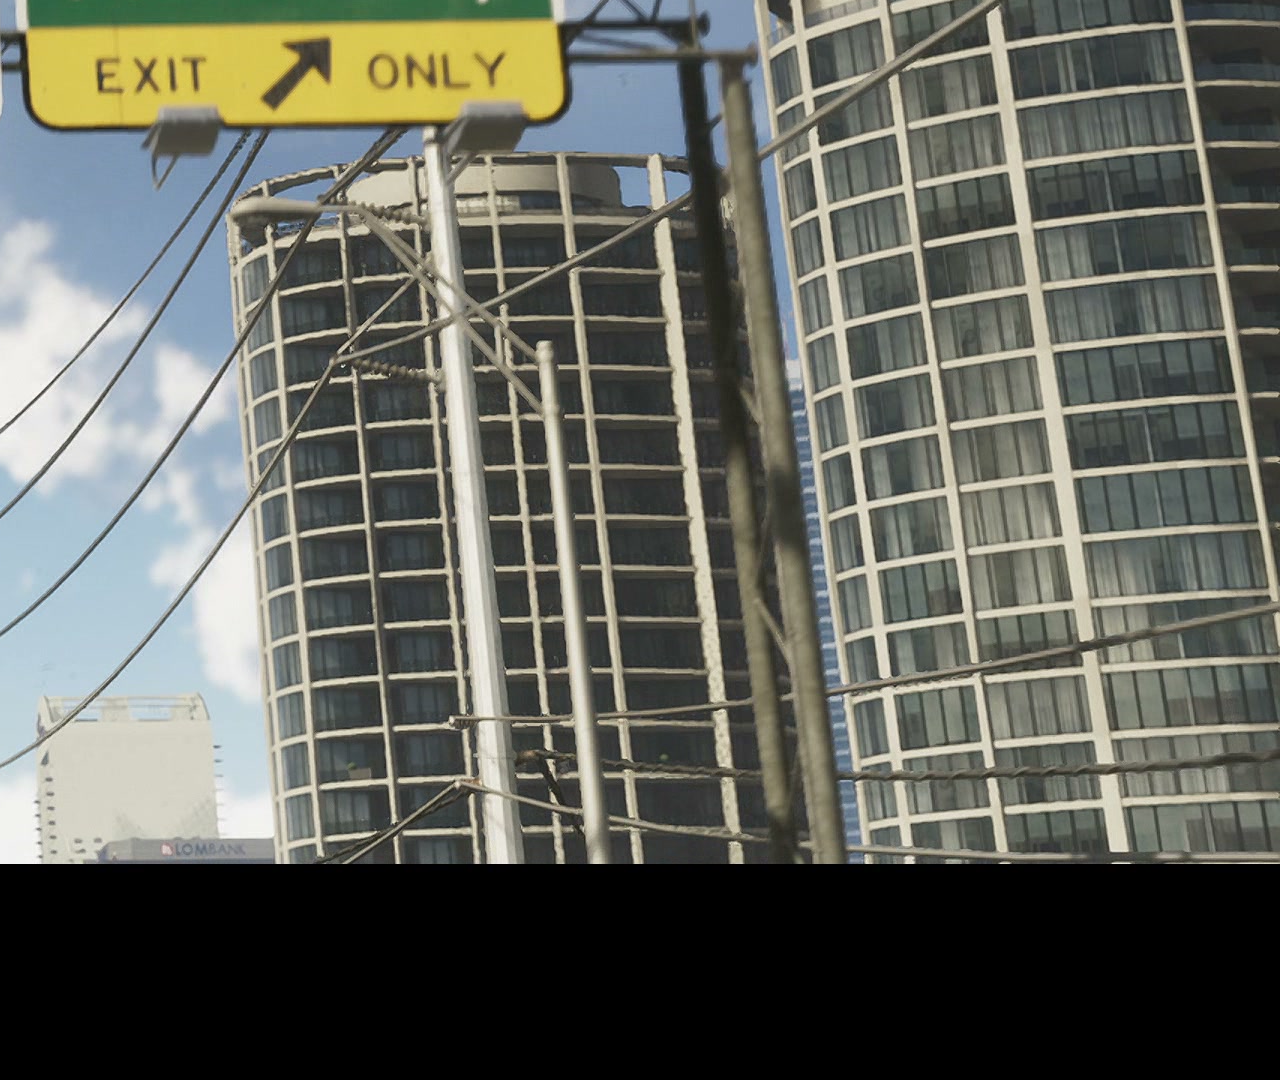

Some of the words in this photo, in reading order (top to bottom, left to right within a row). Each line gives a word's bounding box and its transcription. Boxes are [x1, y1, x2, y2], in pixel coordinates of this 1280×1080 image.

[94, 56, 208, 95] EXIT
[366, 51, 507, 90] ONLY
[175, 842, 247, 857] LOMBANK
